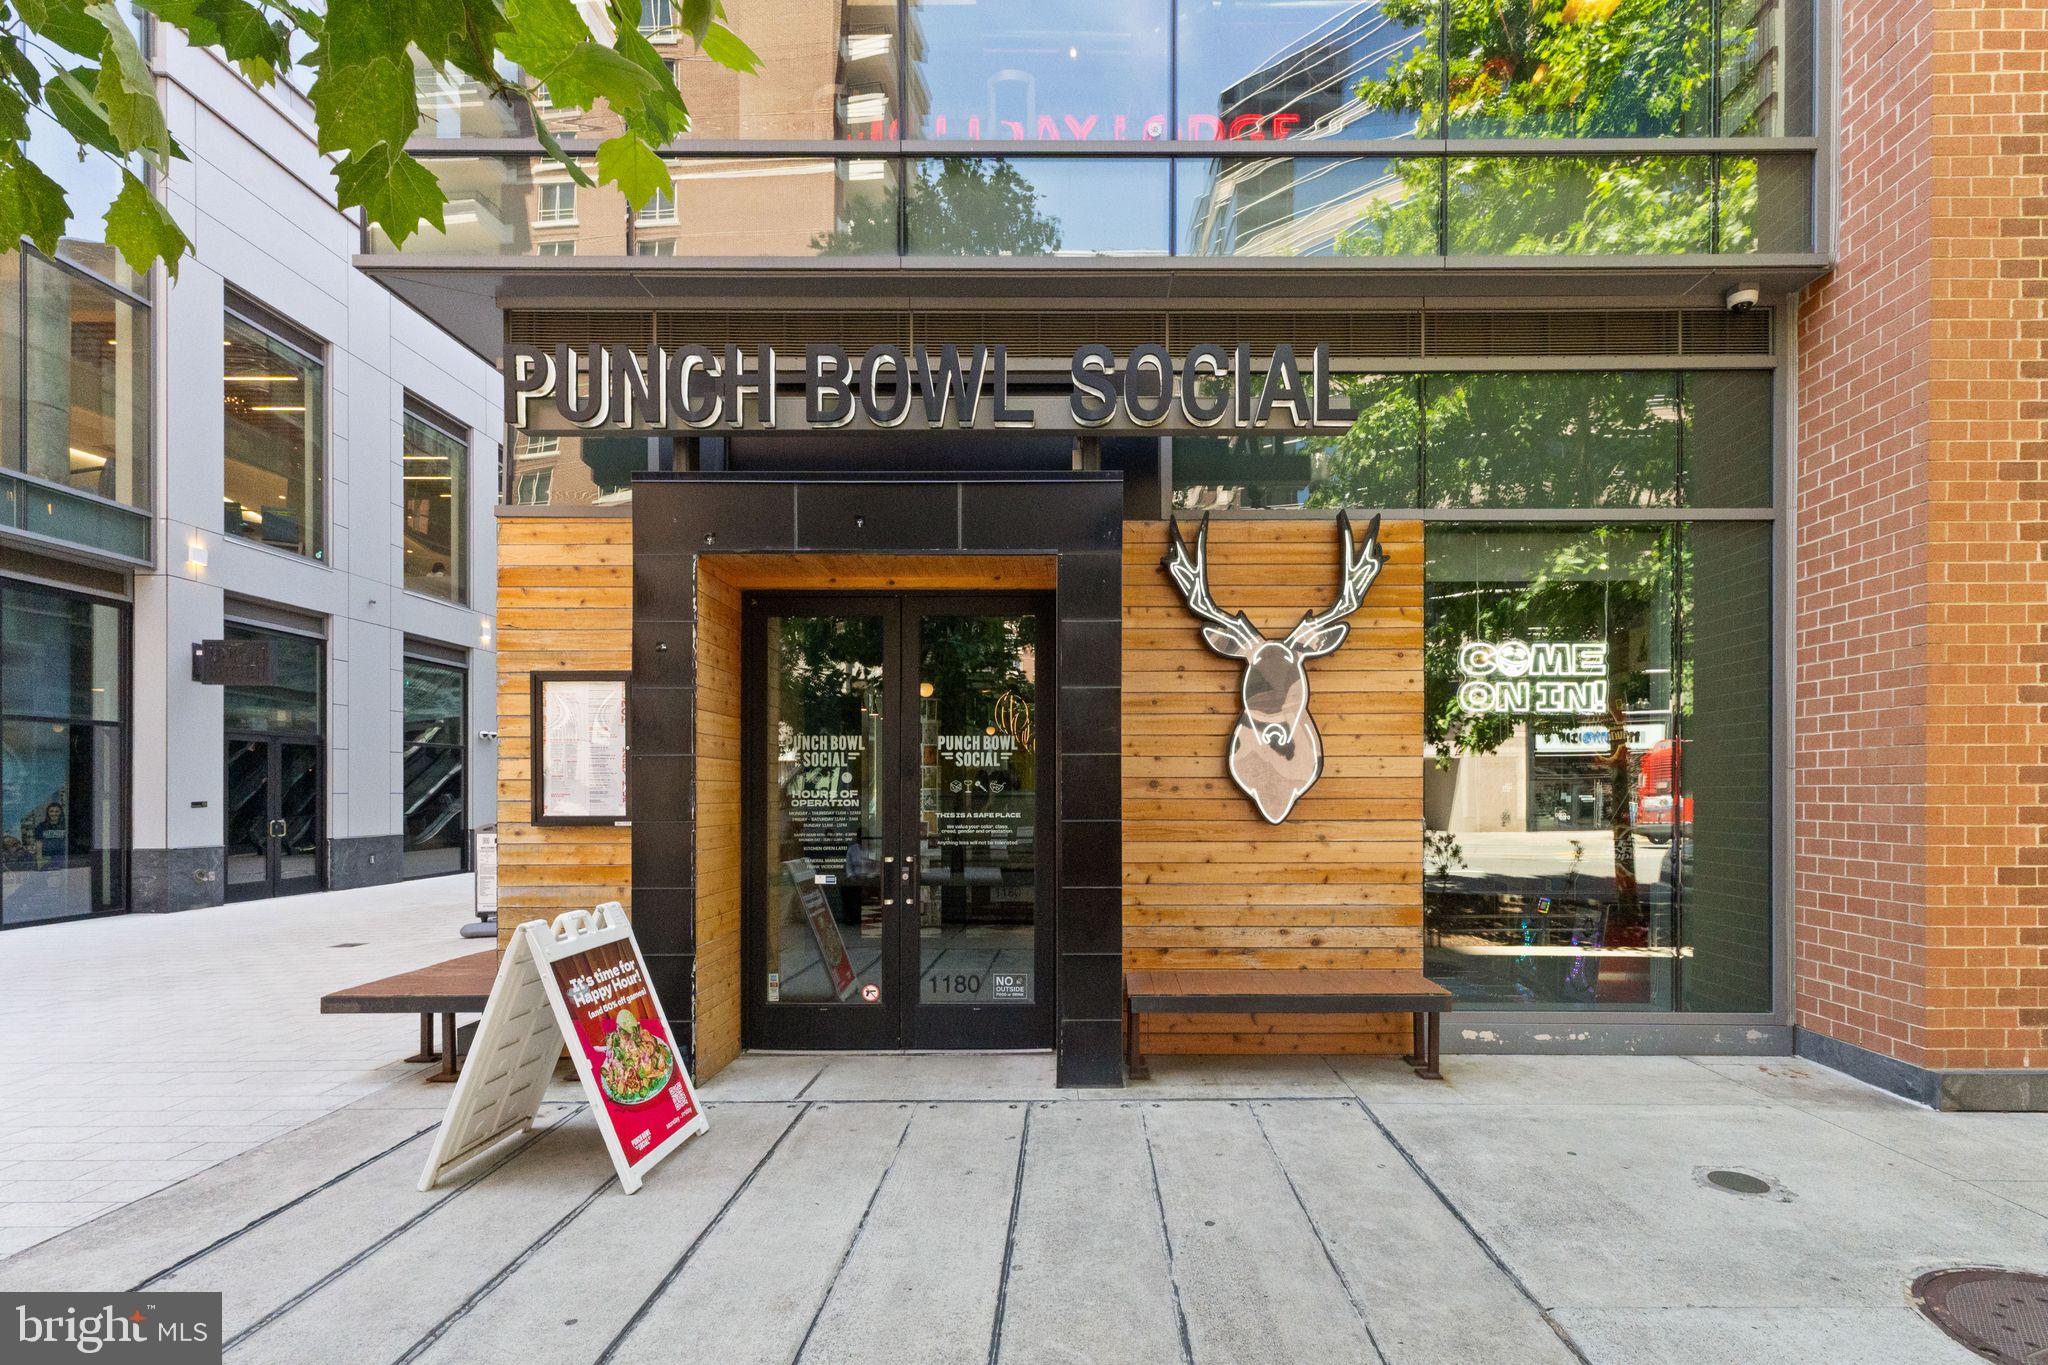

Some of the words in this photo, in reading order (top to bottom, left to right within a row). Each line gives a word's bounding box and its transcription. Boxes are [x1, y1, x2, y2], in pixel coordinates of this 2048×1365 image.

[503, 342, 776, 429] PUNCH
[805, 343, 1035, 428] BOWL
[1070, 343, 1359, 427] SOCIAL
[1459, 641, 1609, 677] COME
[1459, 681, 1530, 713] ON
[1535, 680, 1609, 713] IN!
[786, 735, 828, 750] PUNCH
[830, 735, 866, 750] BOWL
[937, 735, 980, 751] PUNCH
[983, 735, 1018, 750] BOWL
[802, 752, 848, 767] SOCIAL
[955, 752, 1001, 767] SOCIAL
[792, 789, 838, 799] HOURS
[840, 789, 858, 799] OF
[790, 799, 860, 807] OPERATION
[569, 974, 595, 992] It's
[593, 968, 620, 984] time
[619, 960, 635, 973] for
[929, 974, 980, 994] 1180
[995, 976, 1013, 986] NO
[573, 983, 613, 1008] Happy
[611, 969, 642, 992] Hour!
[602, 1000, 618, 1013] 50%
[617, 995, 628, 1006] off
